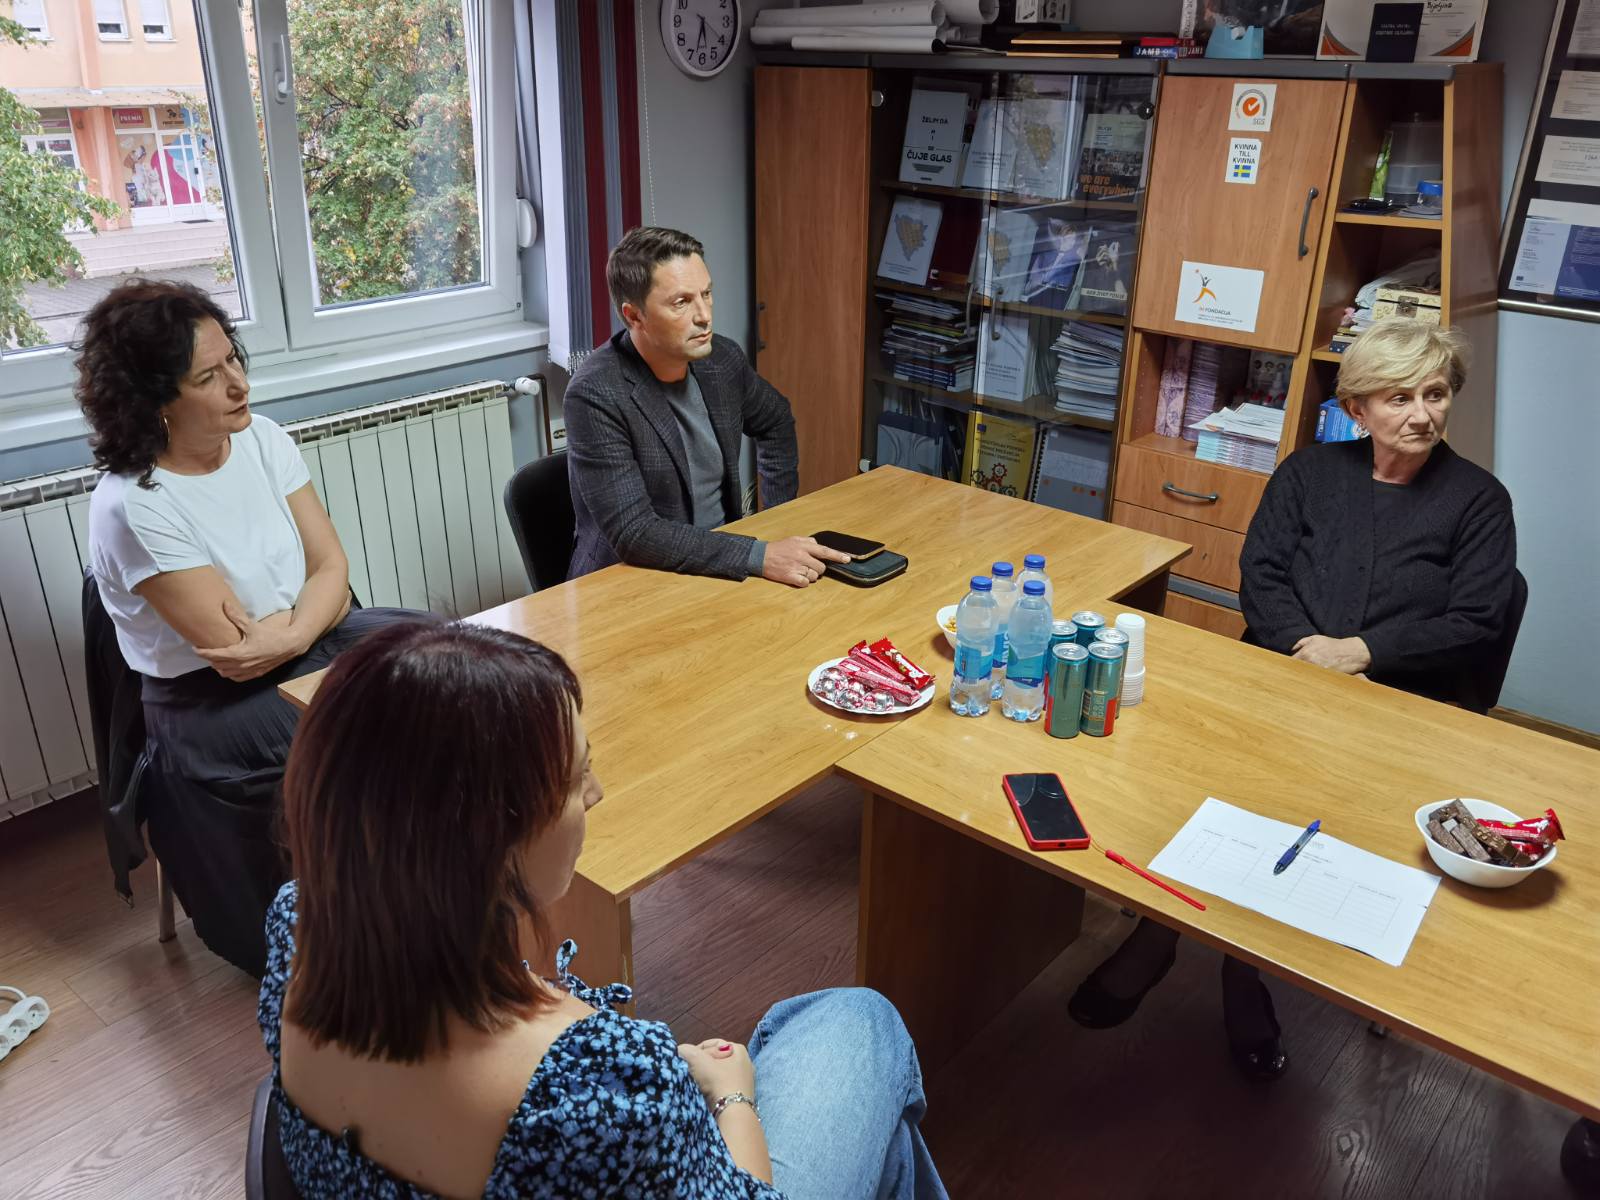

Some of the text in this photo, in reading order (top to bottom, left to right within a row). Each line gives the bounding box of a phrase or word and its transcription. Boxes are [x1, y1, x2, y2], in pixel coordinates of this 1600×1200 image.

[673, 14, 682, 28] 9
[722, 15, 730, 28] 3
[677, 32, 686, 46] 8
[717, 34, 725, 46] 4
[687, 48, 695, 61] 7
[698, 52, 706, 66] 6
[710, 46, 718, 60] 5
[906, 149, 952, 163] ČUJE GLAS
